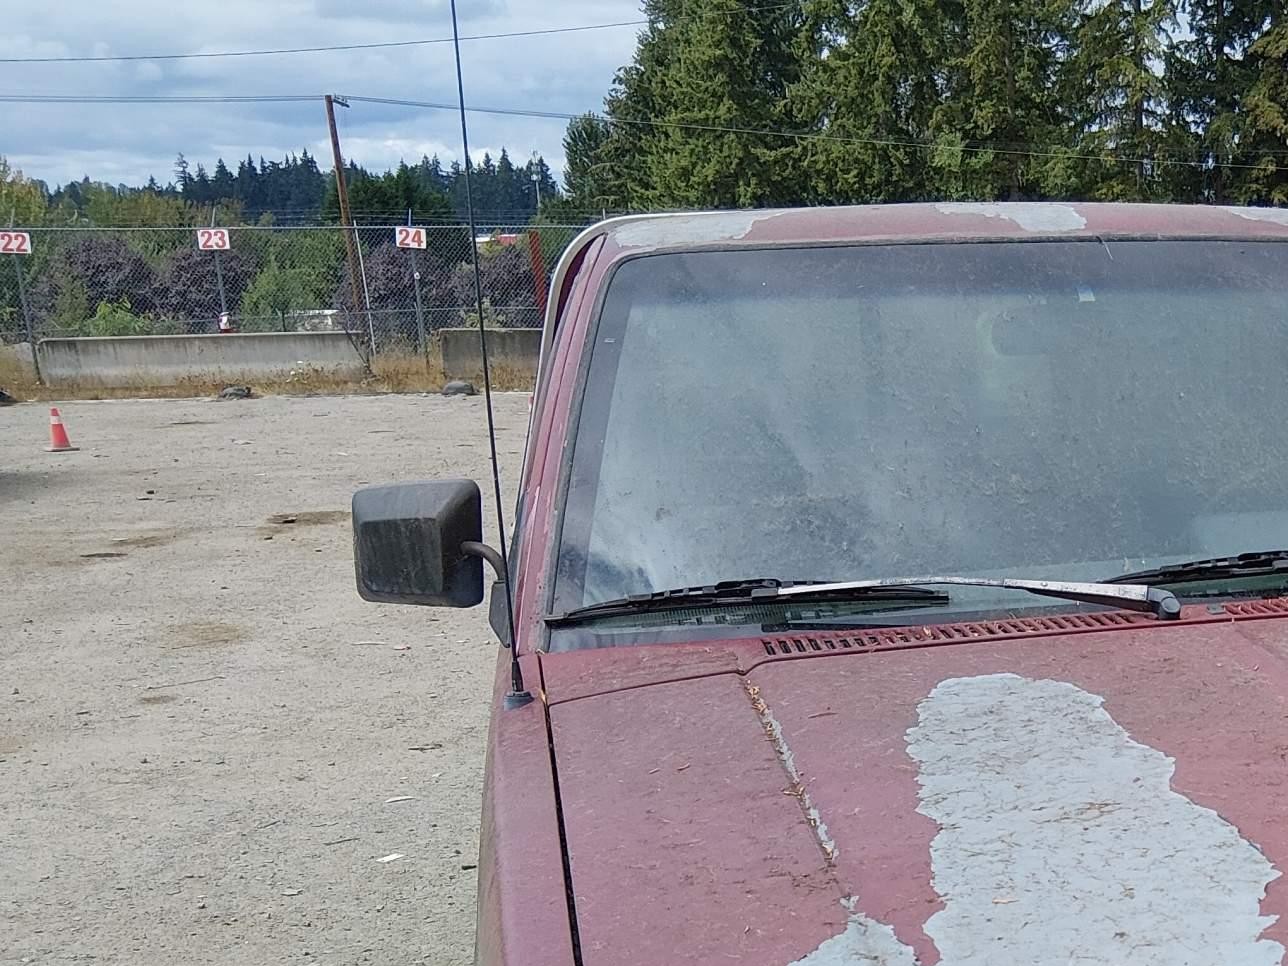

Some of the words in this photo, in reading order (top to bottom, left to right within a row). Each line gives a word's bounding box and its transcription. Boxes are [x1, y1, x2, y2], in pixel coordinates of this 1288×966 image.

[0, 233, 28, 252] 22
[200, 230, 227, 249] 23
[398, 228, 424, 248] 24
